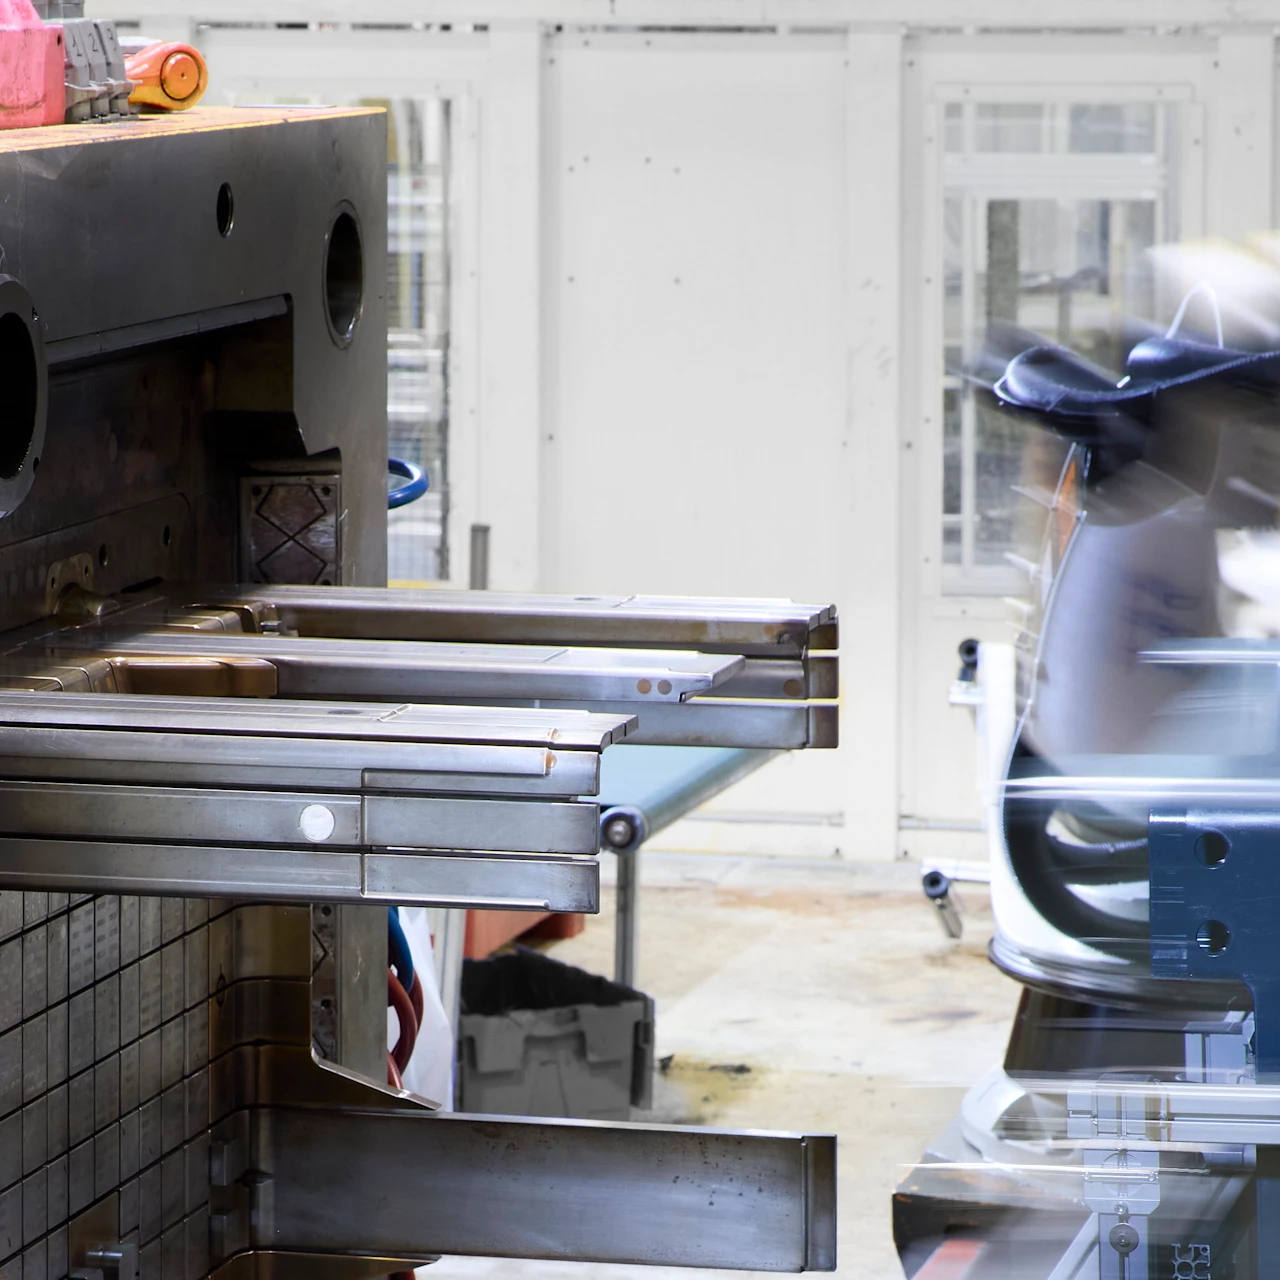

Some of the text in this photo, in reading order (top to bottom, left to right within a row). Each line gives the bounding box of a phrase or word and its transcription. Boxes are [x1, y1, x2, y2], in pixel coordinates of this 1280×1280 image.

[72, 34, 83, 57] 1
[88, 32, 99, 52] 2
[107, 28, 117, 51] 3
